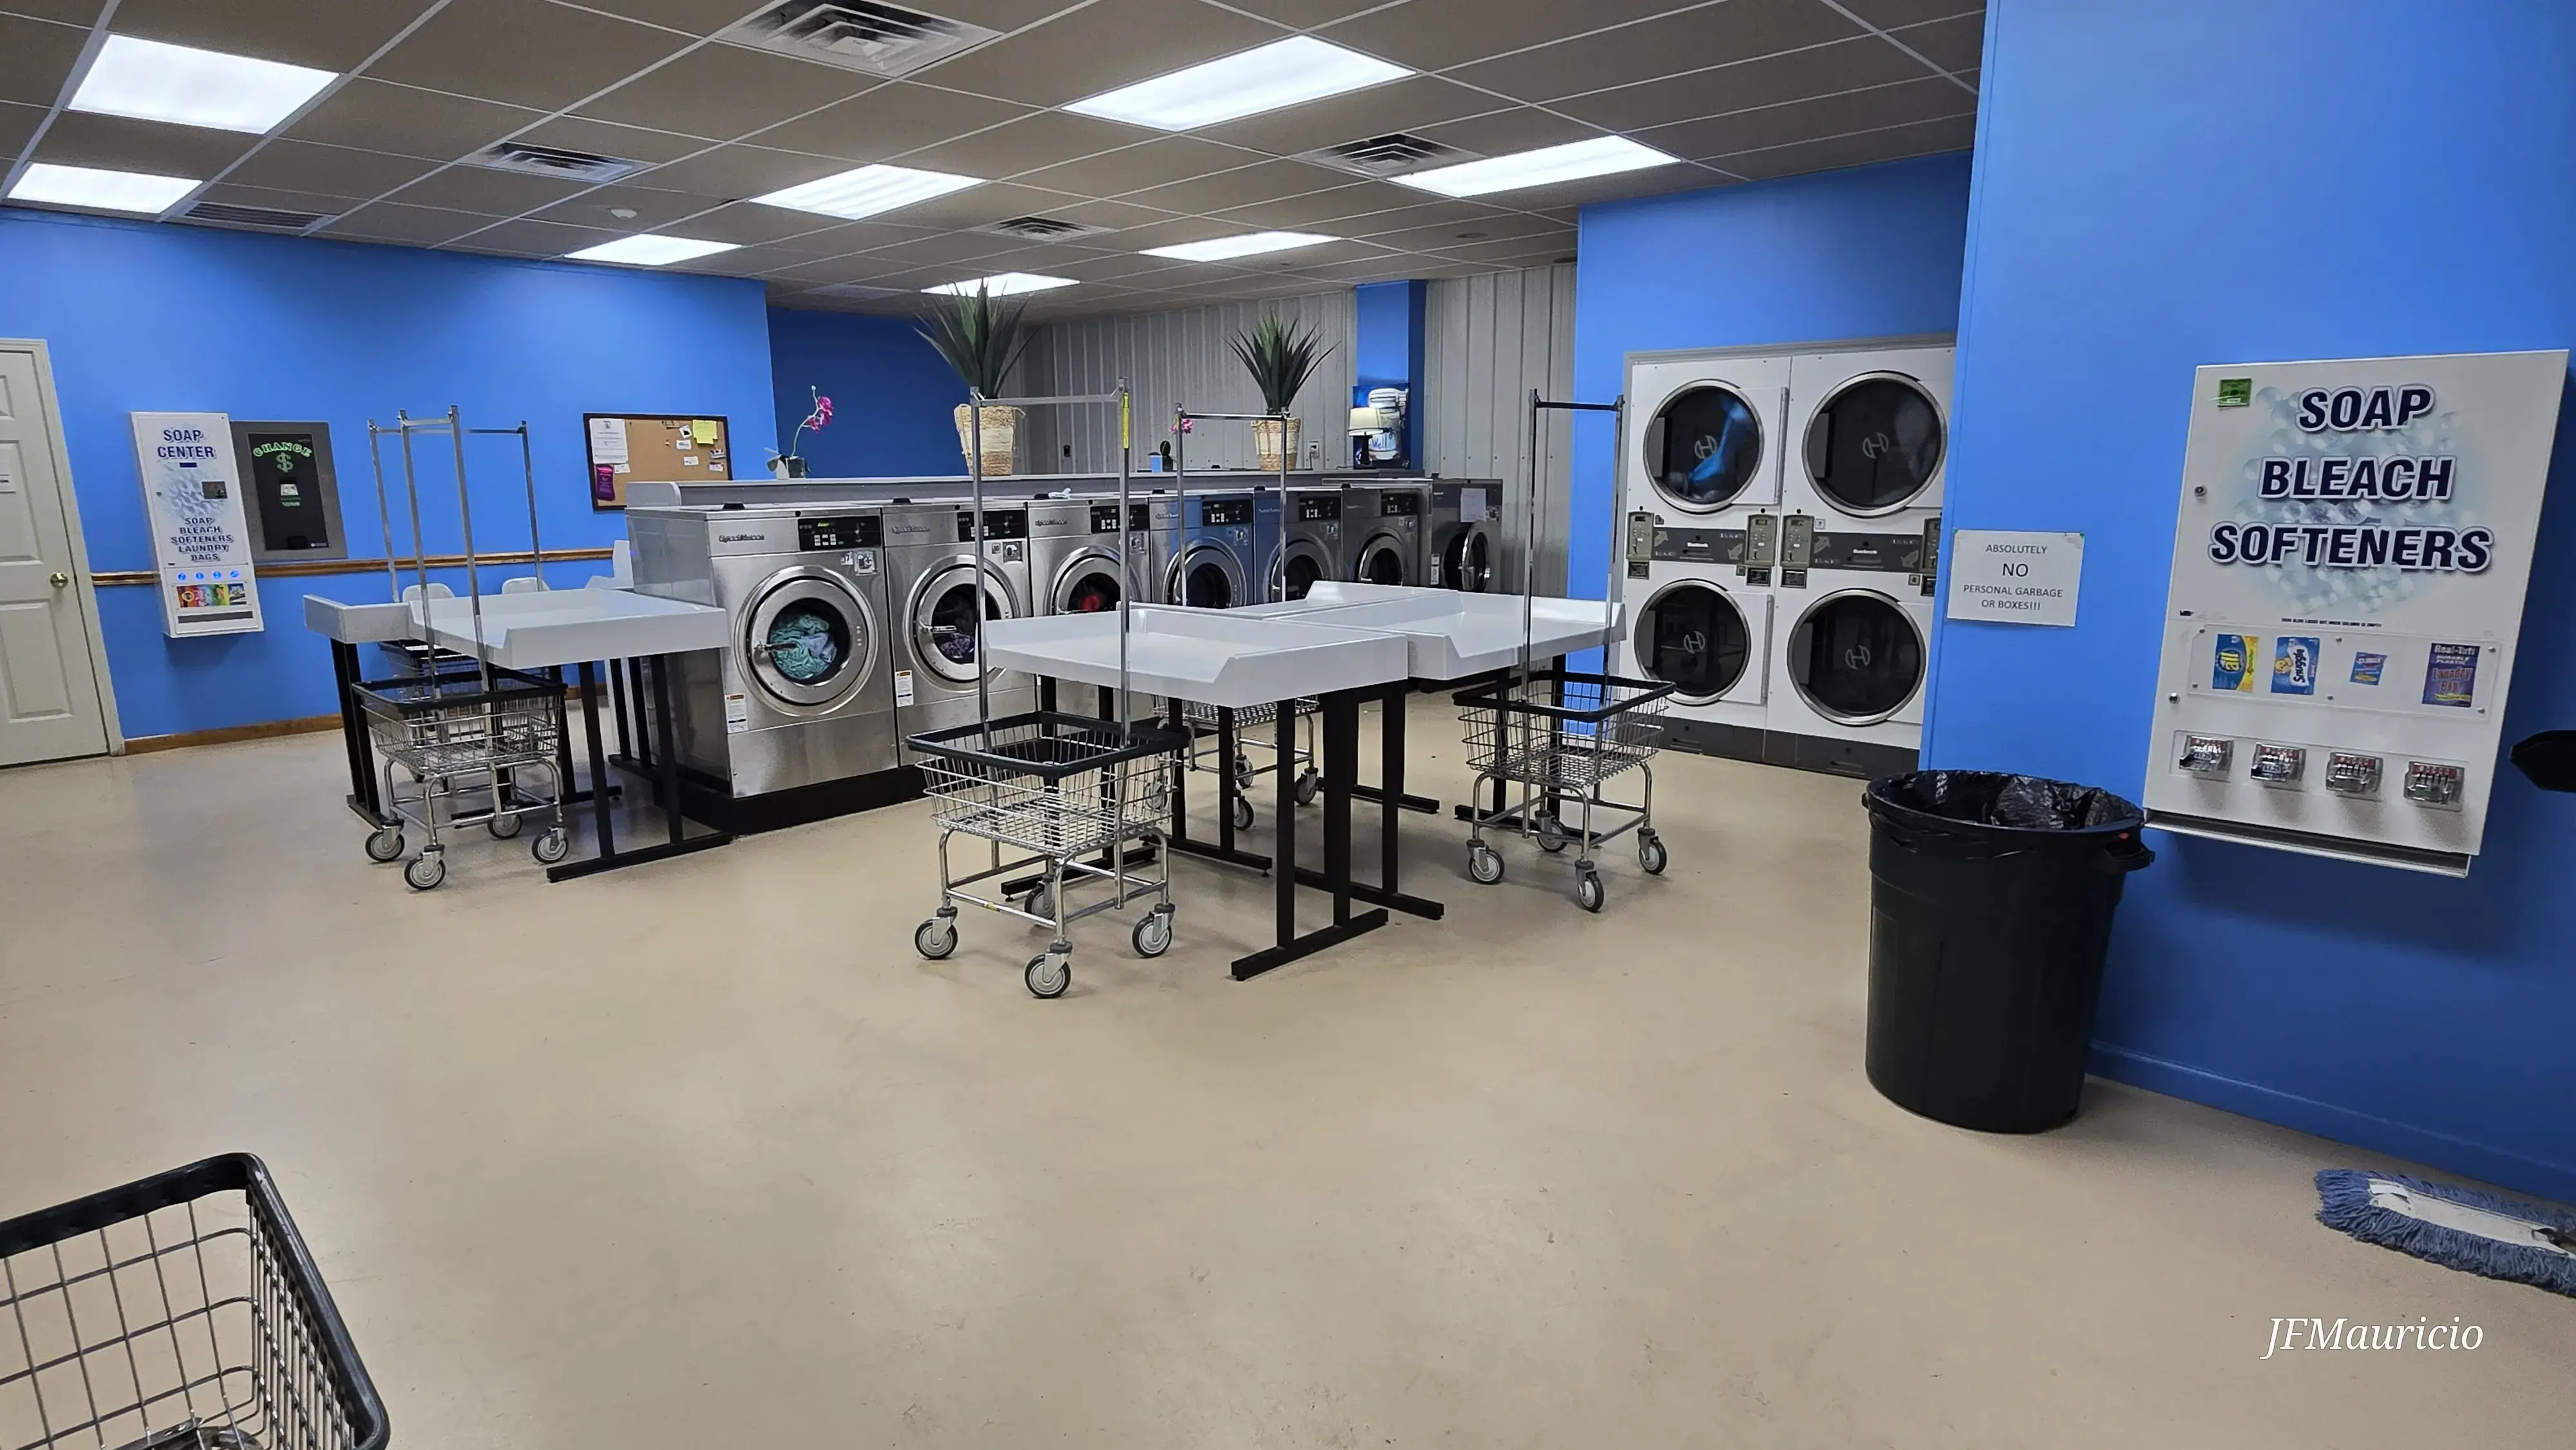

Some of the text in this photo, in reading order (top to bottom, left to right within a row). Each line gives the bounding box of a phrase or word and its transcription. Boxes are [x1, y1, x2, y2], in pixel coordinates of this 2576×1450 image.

[2298, 386, 2432, 429] SOAP
[163, 429, 202, 442] SOAP
[156, 446, 215, 458] CENTER
[253, 442, 312, 457] CHANGE
[2260, 457, 2454, 498] BLEACH
[184, 517, 213, 525] SOAP
[171, 534, 233, 544] SOFTENERS
[178, 544, 229, 552] LAUNDRY
[1985, 544, 2048, 554] ABSOLUTELY
[2210, 523, 2492, 571] SOFTENERS
[2002, 563, 2029, 577] NO
[1963, 584, 2063, 598] PERSONAL GARBAGE
[1982, 599, 2041, 610] OR BOXES!!!
[2221, 652, 2240, 671] all
[2293, 648, 2306, 683] Snuggle
